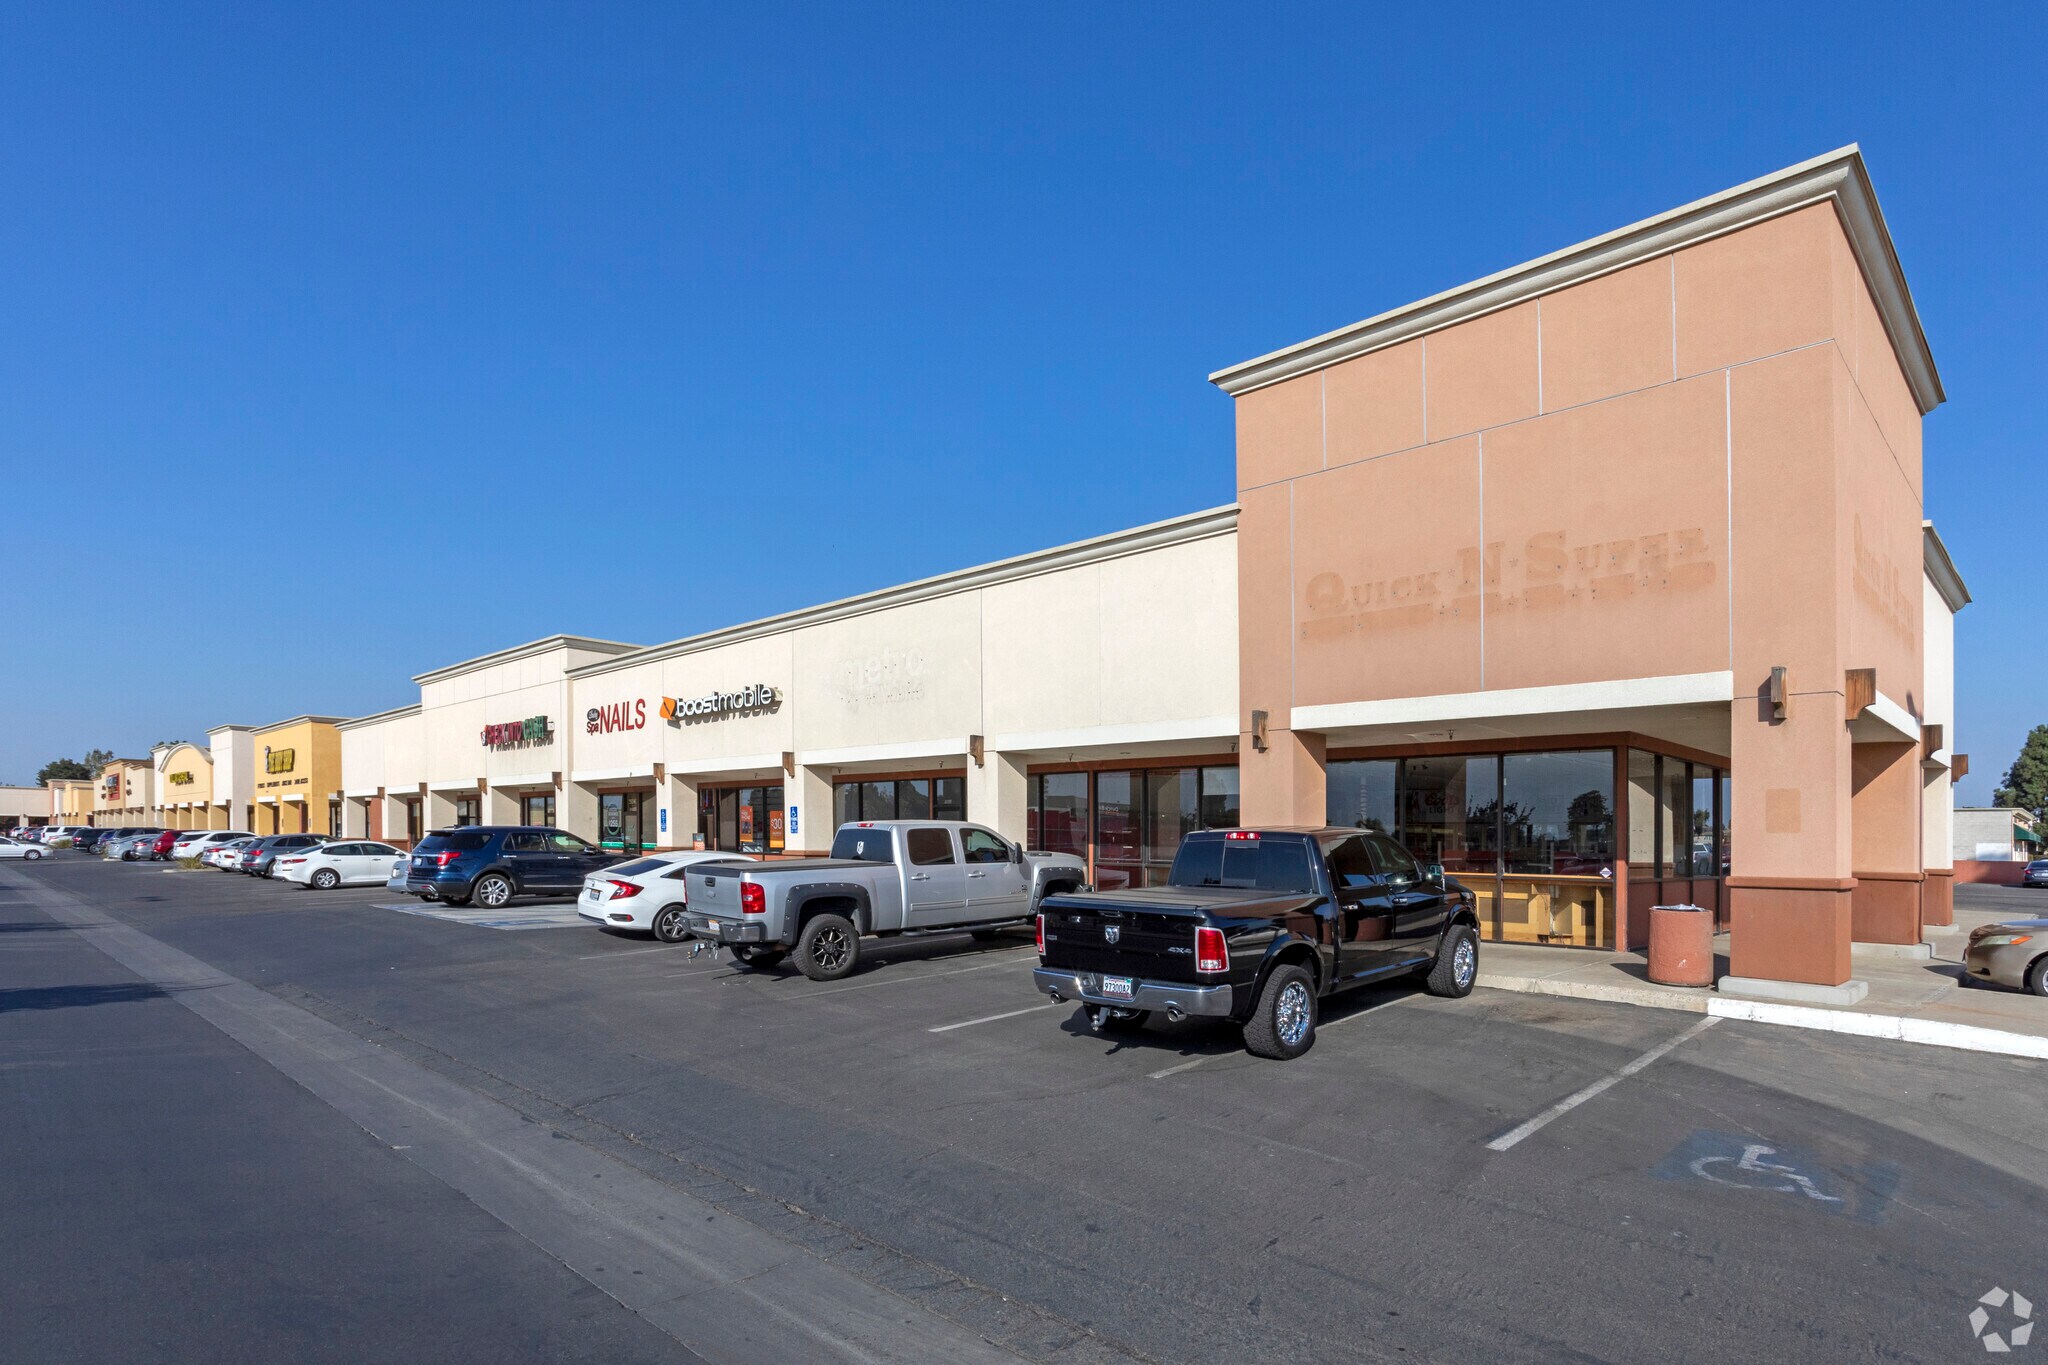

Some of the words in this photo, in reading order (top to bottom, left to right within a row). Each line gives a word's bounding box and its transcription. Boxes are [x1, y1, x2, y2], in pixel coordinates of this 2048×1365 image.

[676, 683, 773, 718] boostmobile
[586, 721, 599, 736] Spa
[600, 698, 646, 734] NAILS
[771, 818, 782, 830] $30
